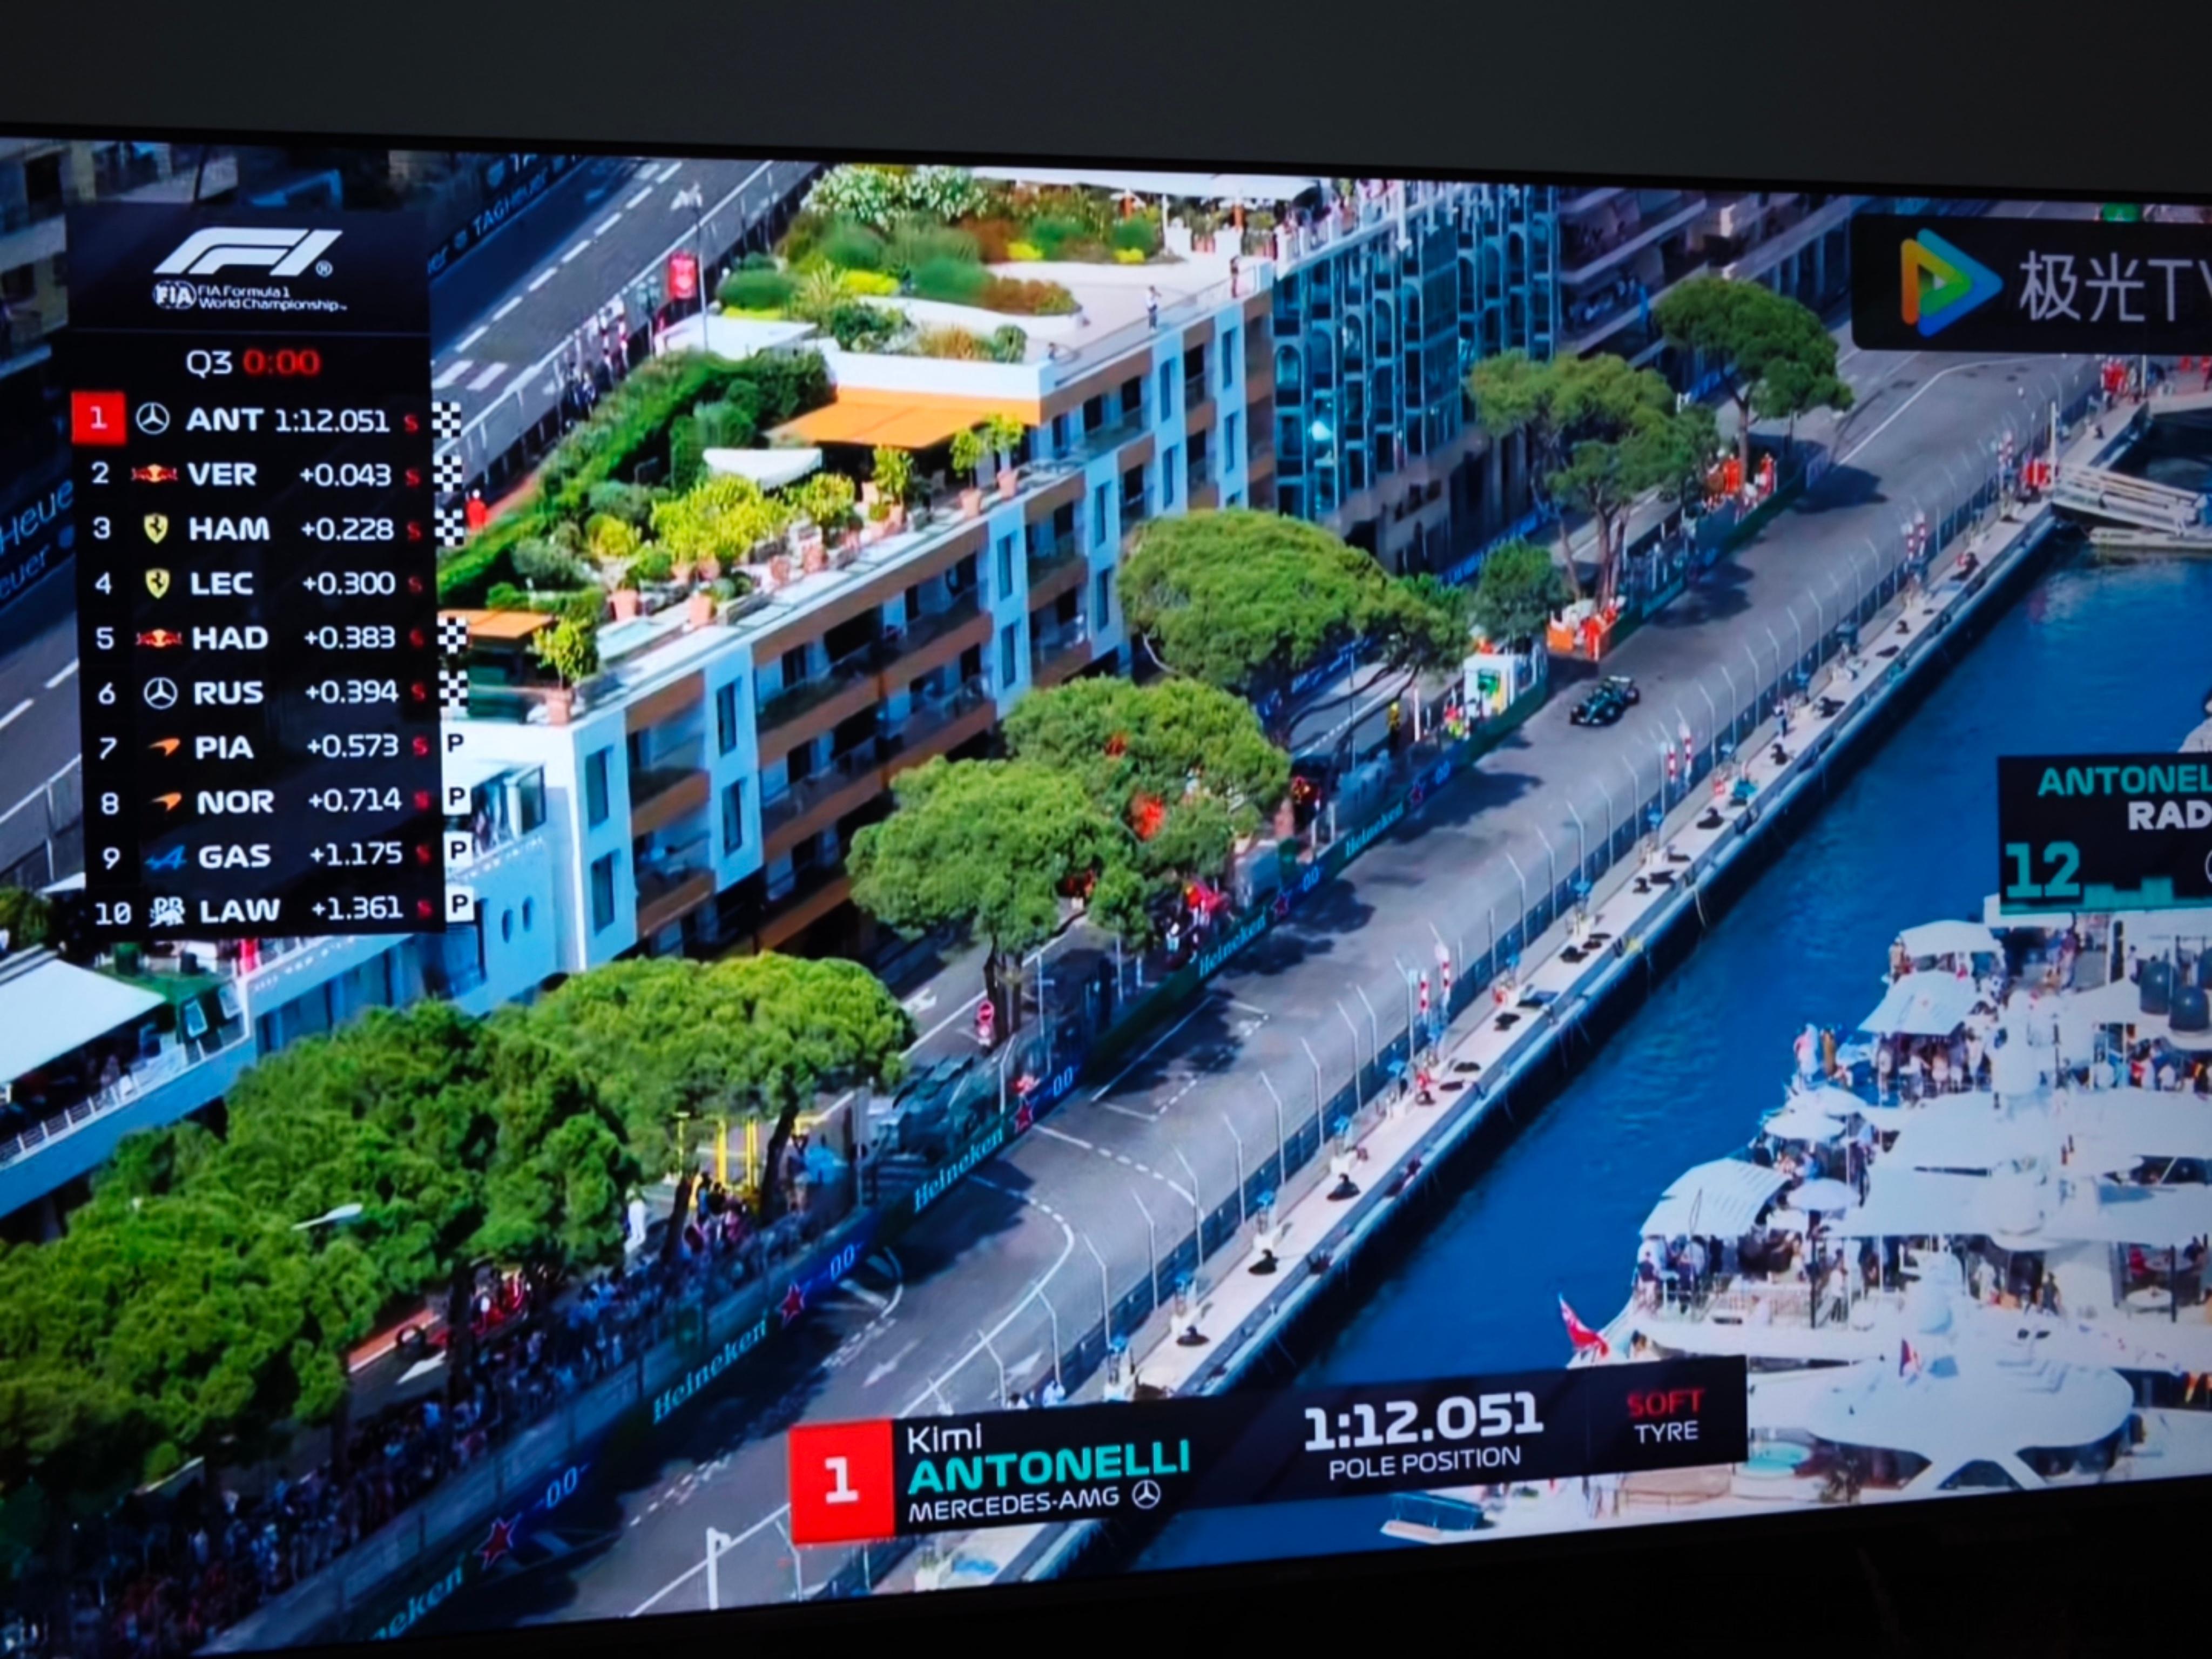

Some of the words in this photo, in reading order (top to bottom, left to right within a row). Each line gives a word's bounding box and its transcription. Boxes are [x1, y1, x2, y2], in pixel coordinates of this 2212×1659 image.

[198, 286, 220, 295] FIA
[224, 286, 281, 298] Formula
[284, 287, 289, 298] 1
[199, 298, 240, 309] World
[242, 299, 338, 312] Championship
[187, 350, 232, 378] Q3
[244, 350, 320, 373] 0:00
[92, 407, 106, 428] 1
[186, 407, 264, 430] ANT
[276, 409, 390, 432] 1:12.051
[404, 414, 419, 433] S
[92, 462, 108, 483] 2
[187, 462, 257, 485] VER
[301, 463, 391, 486] +0.043
[93, 517, 110, 539] 3
[190, 517, 269, 540] HAM
[302, 517, 394, 541] +0.228
[407, 522, 421, 540] S
[95, 572, 111, 594] 4
[191, 572, 253, 595] LEC
[304, 571, 395, 595] +0.300
[97, 627, 113, 649] 5
[193, 626, 268, 650] HAD
[305, 626, 395, 649] +0.383
[98, 683, 115, 704] 6
[194, 681, 264, 705] RUS
[306, 680, 399, 704] +0.394
[411, 683, 426, 701] S
[100, 737, 117, 759] 7
[196, 736, 254, 759] PIA
[308, 734, 398, 758] +0.573
[413, 737, 428, 756] S
[448, 734, 463, 751] P
[2038, 765, 2212, 796] ANTONEL
[102, 792, 119, 814] 8
[198, 790, 274, 814] NOR
[309, 787, 402, 812] +0.714
[450, 788, 464, 805] P
[2129, 800, 2212, 830] RAD
[103, 847, 120, 869] 9
[199, 844, 271, 868] GAS
[310, 842, 402, 866] +1.175
[451, 841, 466, 859] P
[2006, 842, 2080, 898] 12
[96, 902, 131, 925] 10
[200, 899, 280, 923] LAW
[313, 895, 403, 920] +1.361
[453, 895, 467, 912] P
[653, 1317, 767, 1424] Heineken
[1628, 1390, 1701, 1417] SOFT
[1305, 1391, 1543, 1451] 1:12.051
[1635, 1421, 1698, 1443] TYRE
[908, 1423, 981, 1454] Kimi
[908, 1439, 1189, 1494] ANTONELLI
[1329, 1456, 1395, 1480] POLE
[1403, 1446, 1521, 1473] POSITION
[825, 1457, 858, 1503] 1
